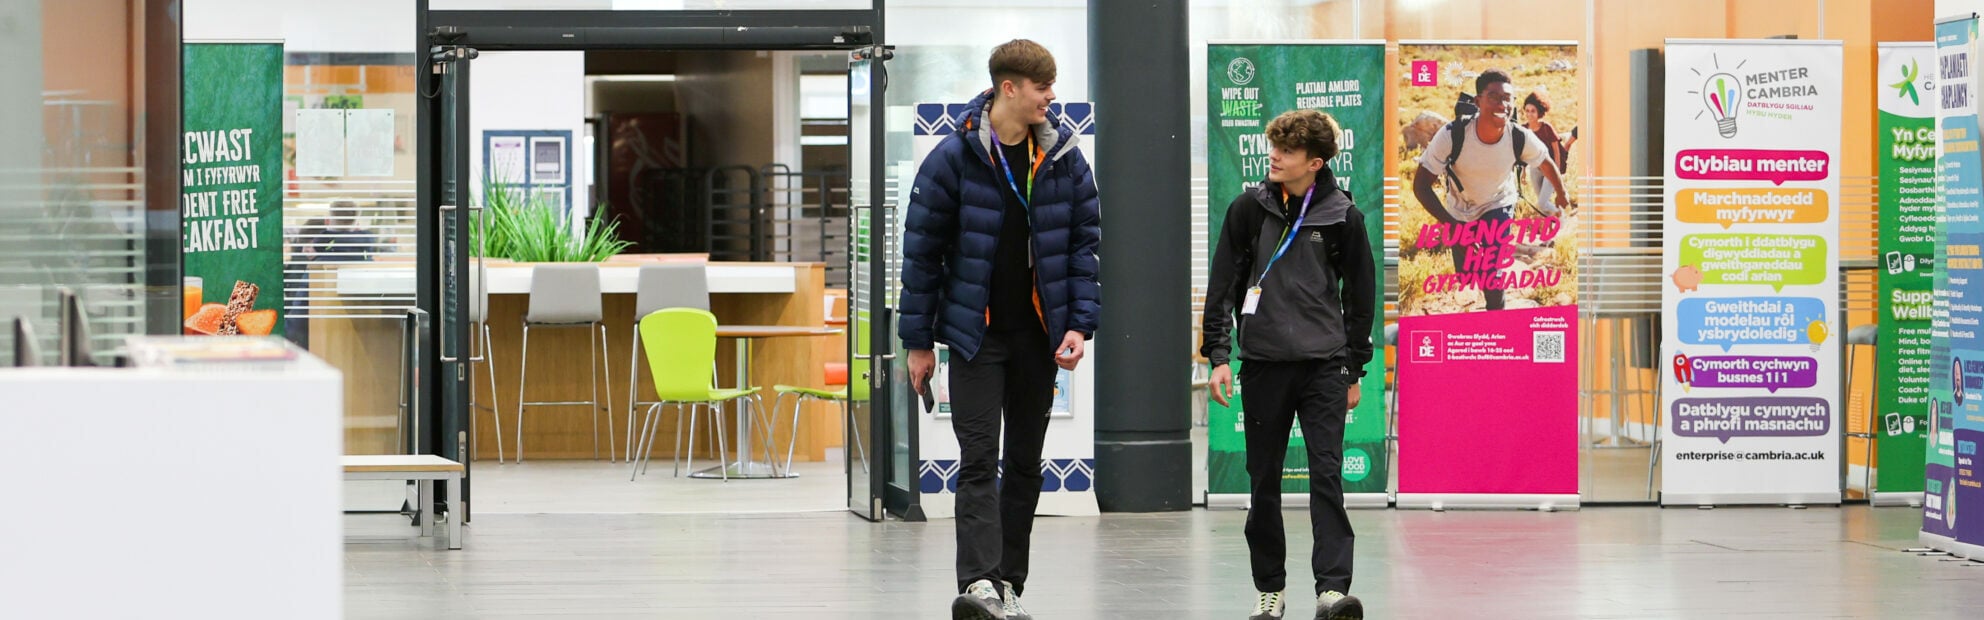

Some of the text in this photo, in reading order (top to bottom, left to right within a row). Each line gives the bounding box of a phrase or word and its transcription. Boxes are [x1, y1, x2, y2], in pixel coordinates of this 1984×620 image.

[1418, 73, 1431, 82] DE
[1746, 67, 1808, 86] MENTER
[1222, 87, 1259, 100] WIPE OUT
[1296, 80, 1360, 94] PLATIAU AMLDRO
[1747, 84, 1818, 100] CAMBRIA
[1297, 94, 1362, 109] REUSABLE PLATES
[1746, 110, 1792, 120] HYBU HYDER
[1893, 128, 1913, 141] Yn
[184, 128, 253, 164] CWAST
[1680, 156, 1826, 173] Clybiau menter
[184, 164, 260, 187] M I FYFYRWYR
[222, 189, 258, 216] FREE
[1693, 192, 1813, 205] Marchnadoedd
[1716, 206, 1795, 222] myfyrwyr
[1416, 216, 1561, 250] IEUENCTID
[1689, 236, 1744, 249] Cymorth
[1752, 236, 1816, 250] ddatblygu
[1464, 245, 1516, 271] HEB
[1703, 249, 1801, 261] digwyddiadau a
[1701, 260, 1803, 272] gweithgareddau
[1422, 270, 1562, 295] GYFYNGIADAU
[1721, 271, 1782, 281] codi arian
[1705, 300, 1794, 313] Gweithdai a
[1704, 314, 1794, 326] modelau rôl
[1698, 327, 1797, 342] ysbrydoledig
[1419, 346, 1435, 357] DE
[1693, 358, 1810, 374] Cymorth cychwyn
[1718, 372, 1764, 383] busnes
[1766, 372, 1772, 383] 1
[1782, 372, 1788, 383] 1
[1679, 404, 1826, 422] Datblygu cynnyrch
[1680, 417, 1824, 433] a phrofi masnachu
